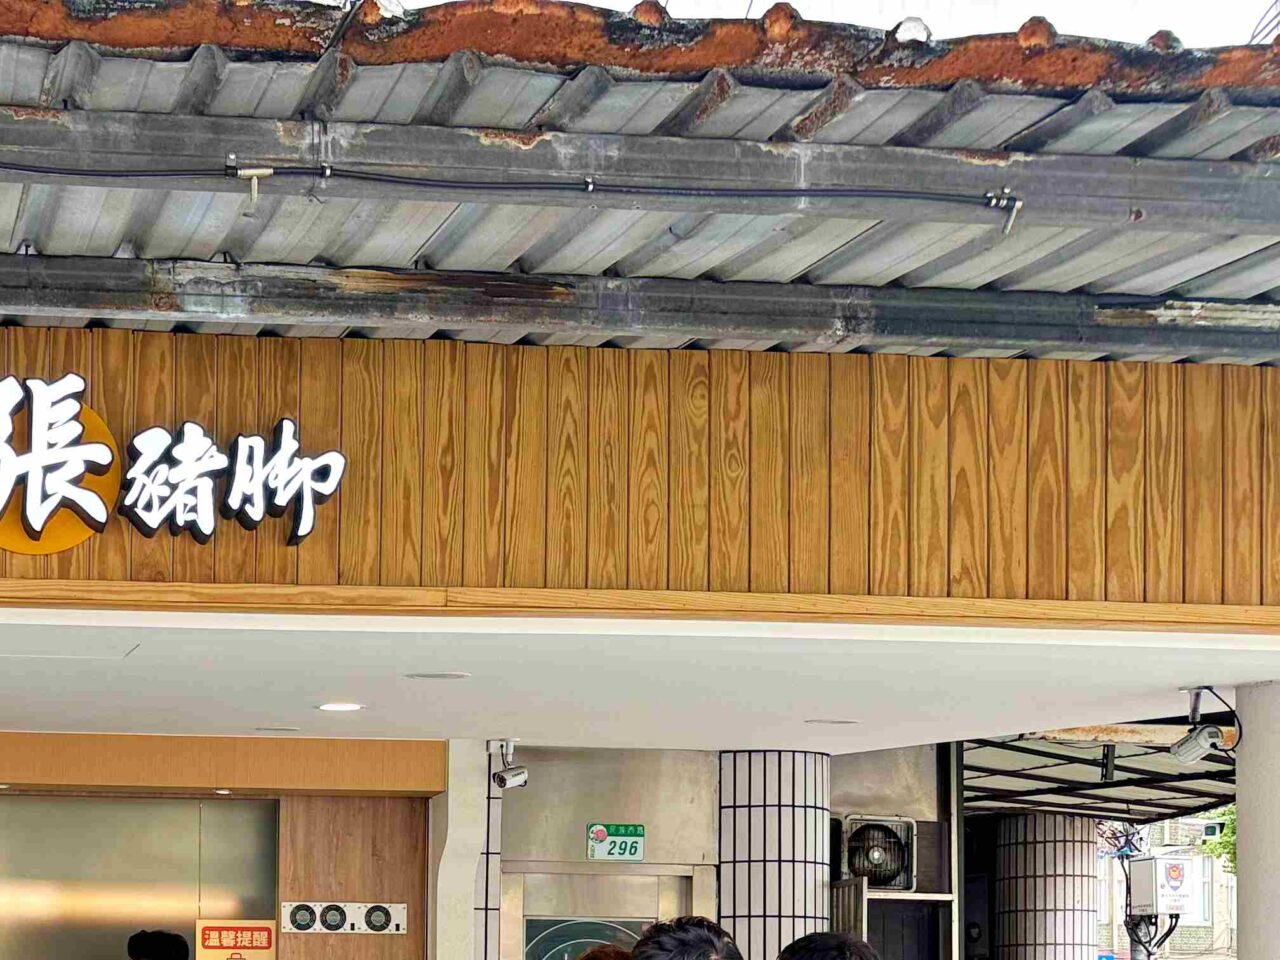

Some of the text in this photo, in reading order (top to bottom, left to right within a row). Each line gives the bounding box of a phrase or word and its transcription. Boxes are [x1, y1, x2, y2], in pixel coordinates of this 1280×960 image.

[607, 840, 639, 856] 296
[204, 930, 269, 947] 溫馨提醒
